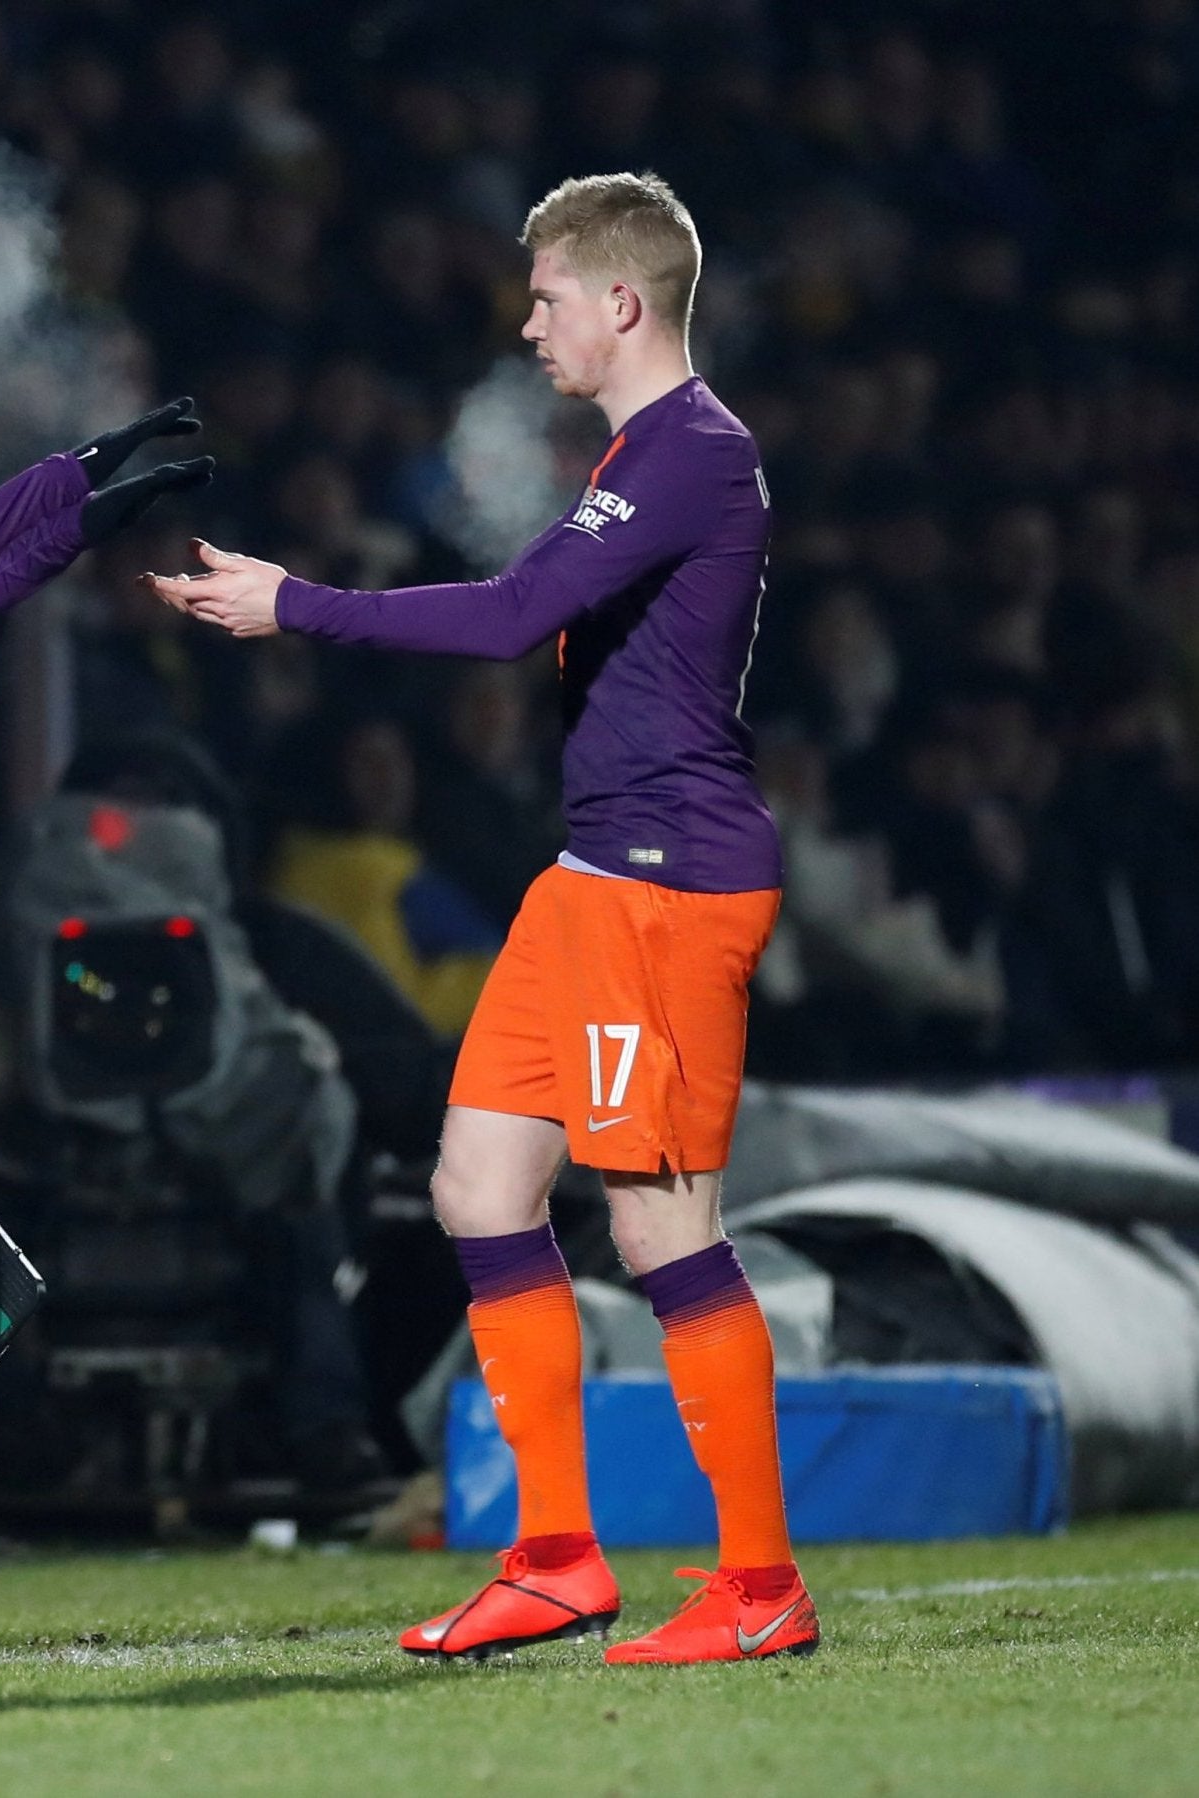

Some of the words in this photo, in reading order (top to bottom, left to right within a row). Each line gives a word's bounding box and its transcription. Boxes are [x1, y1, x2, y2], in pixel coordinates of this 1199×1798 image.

[572, 506, 610, 531] IRE
[585, 1023, 641, 1108] 17
[683, 1421, 707, 1432] TY
